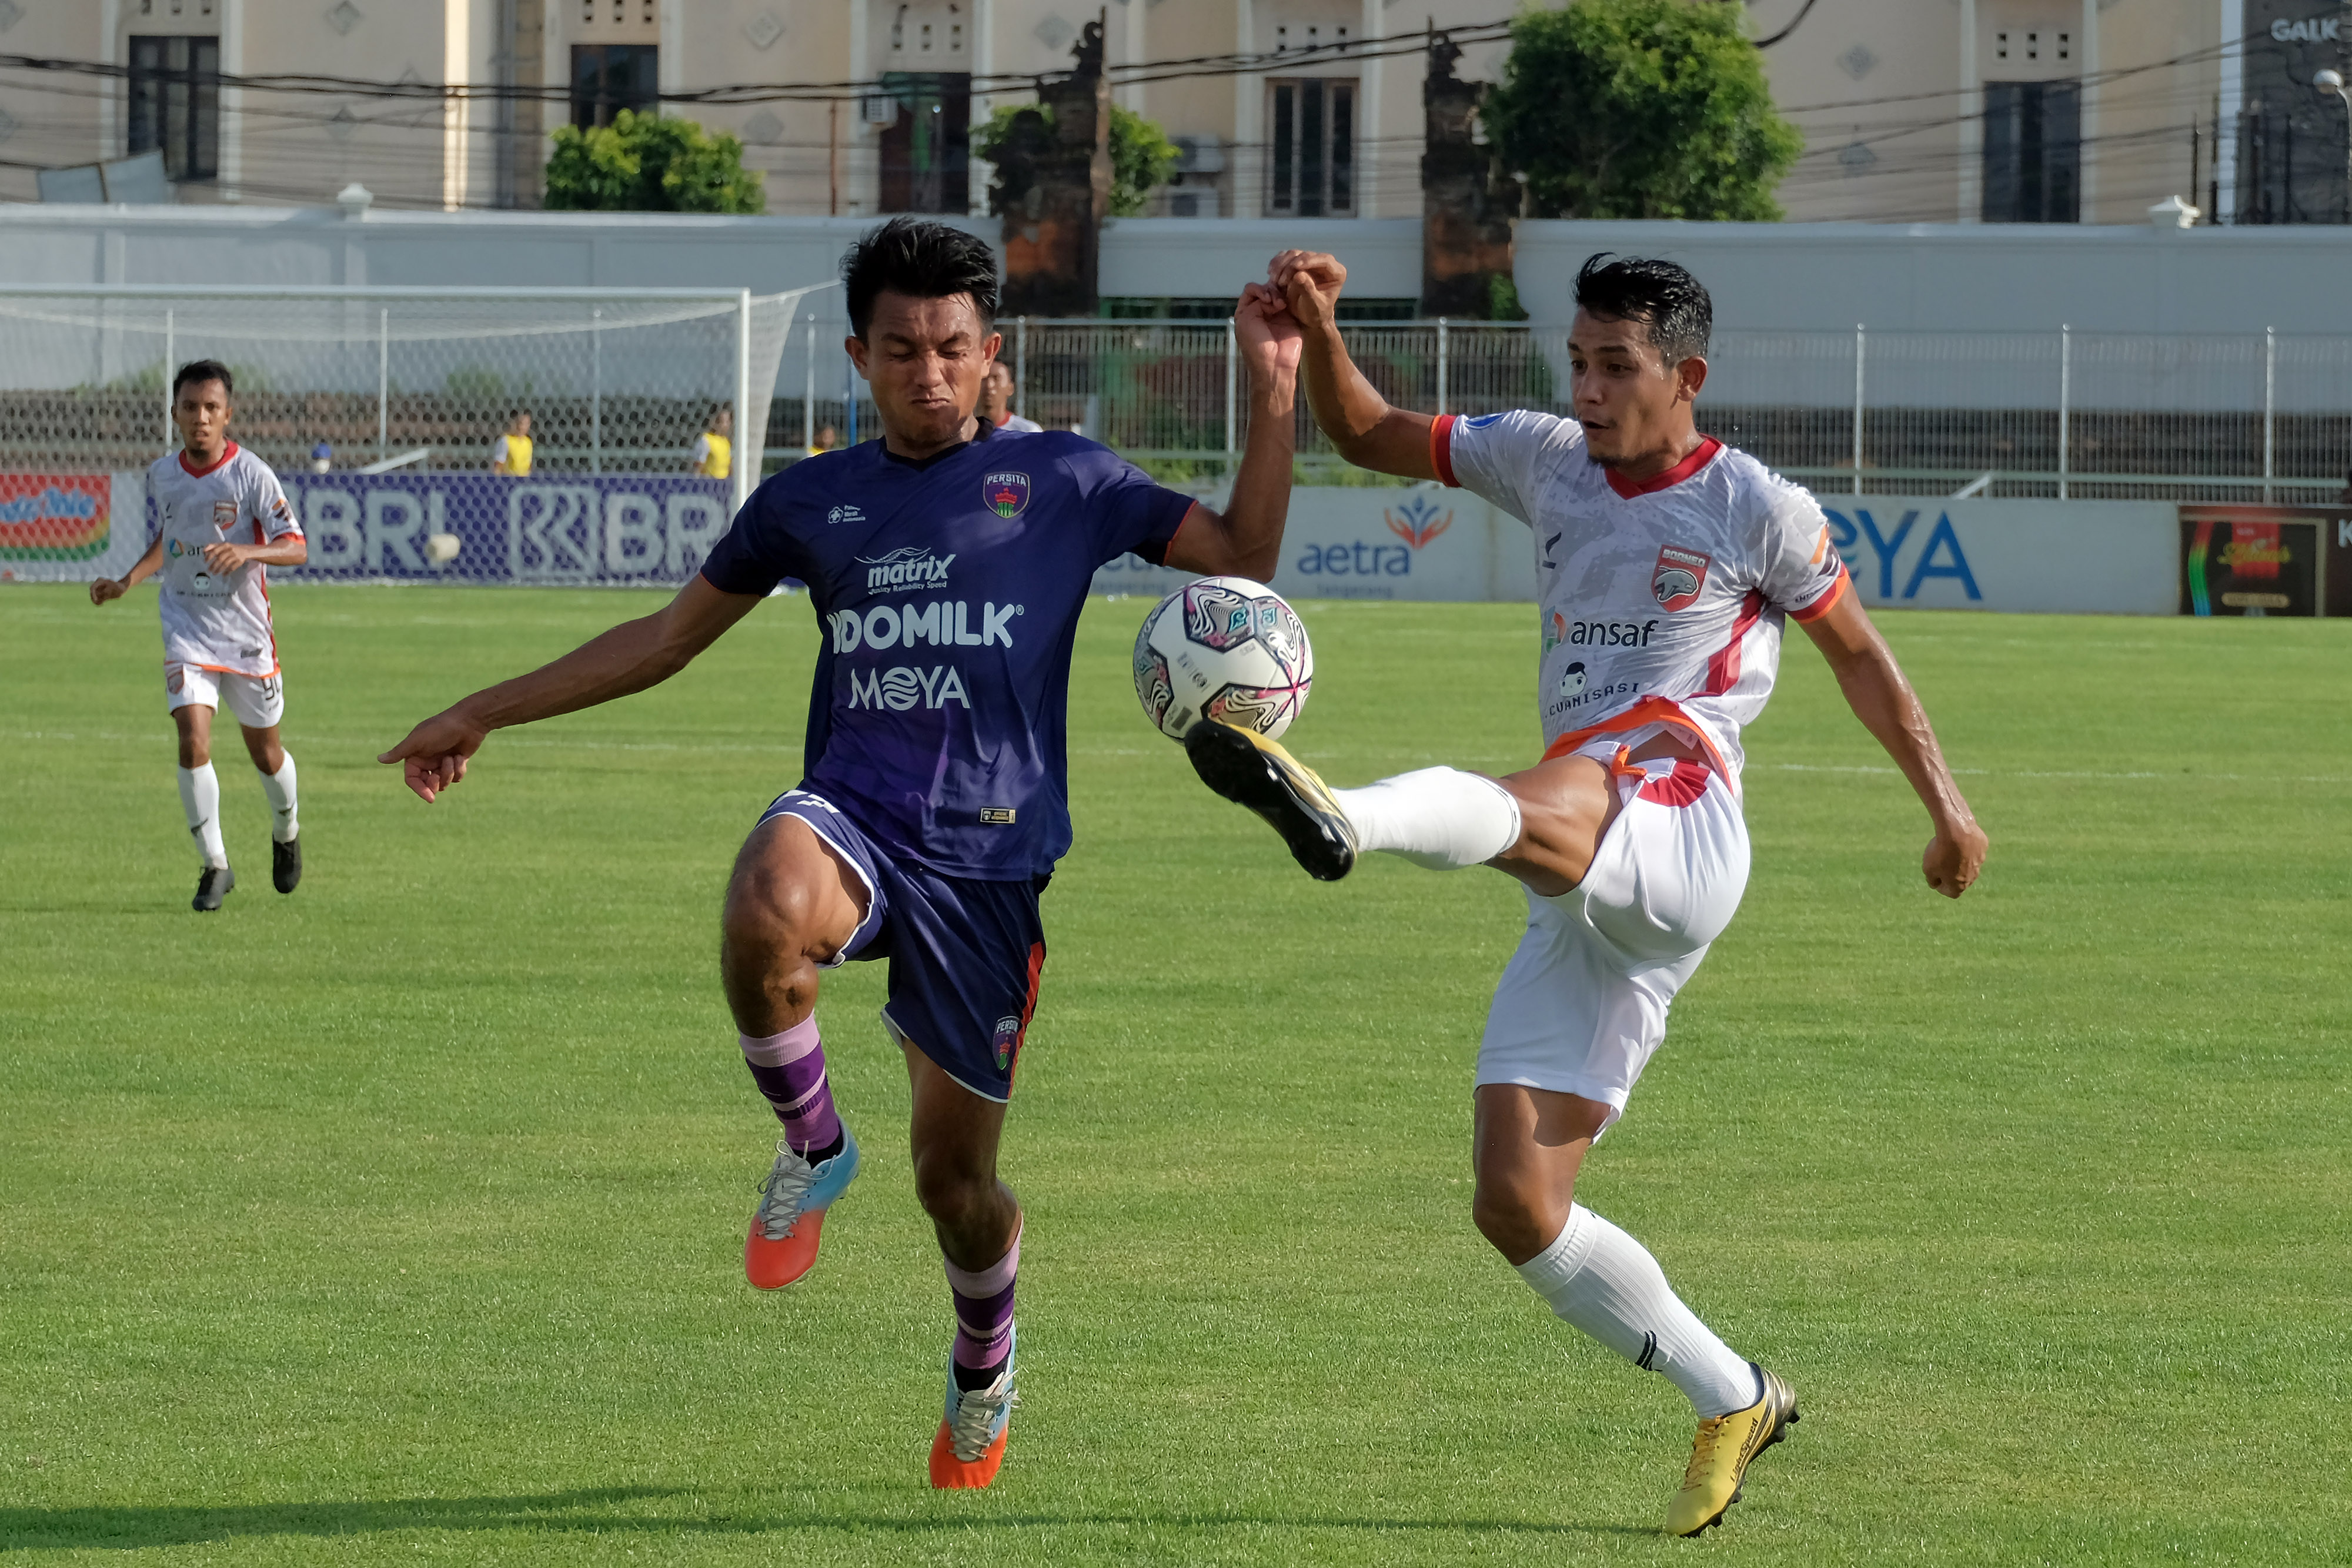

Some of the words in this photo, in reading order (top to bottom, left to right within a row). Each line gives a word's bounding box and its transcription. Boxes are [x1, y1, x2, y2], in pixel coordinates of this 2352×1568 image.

[987, 474, 1027, 487] PERSITA
[306, 489, 445, 568] BRI
[607, 494, 735, 573] BR
[868, 554, 956, 587] matrix
[1298, 540, 1409, 576] aetra
[1662, 549, 1706, 567] BORNEO
[1823, 508, 1983, 600] YA
[927, 580, 947, 589] Speed
[1571, 620, 1659, 647] ansaf
[848, 665, 970, 711] MOYA
